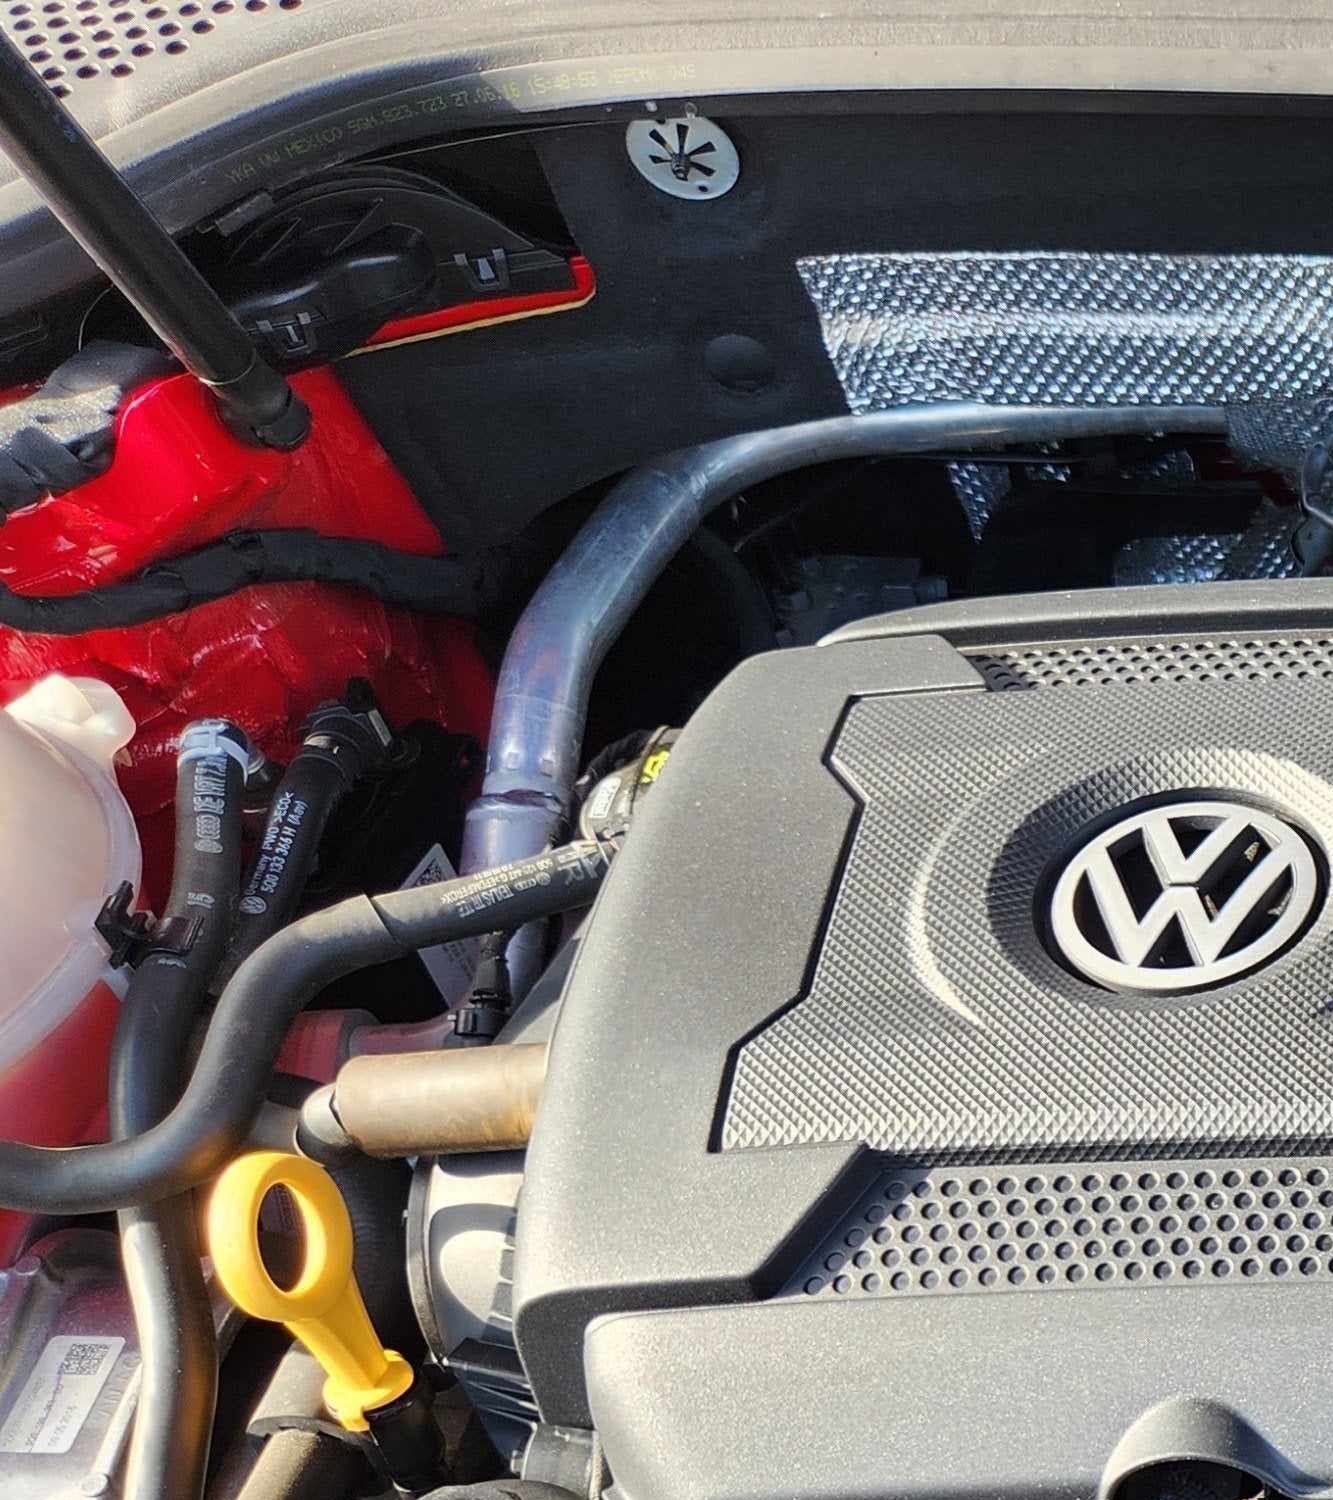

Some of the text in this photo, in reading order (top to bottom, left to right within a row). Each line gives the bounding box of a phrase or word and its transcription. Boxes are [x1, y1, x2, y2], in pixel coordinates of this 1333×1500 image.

[282, 826, 297, 836] H
[275, 837, 293, 855] 366
[270, 857, 286, 873] 133
[244, 855, 272, 895] Germany
